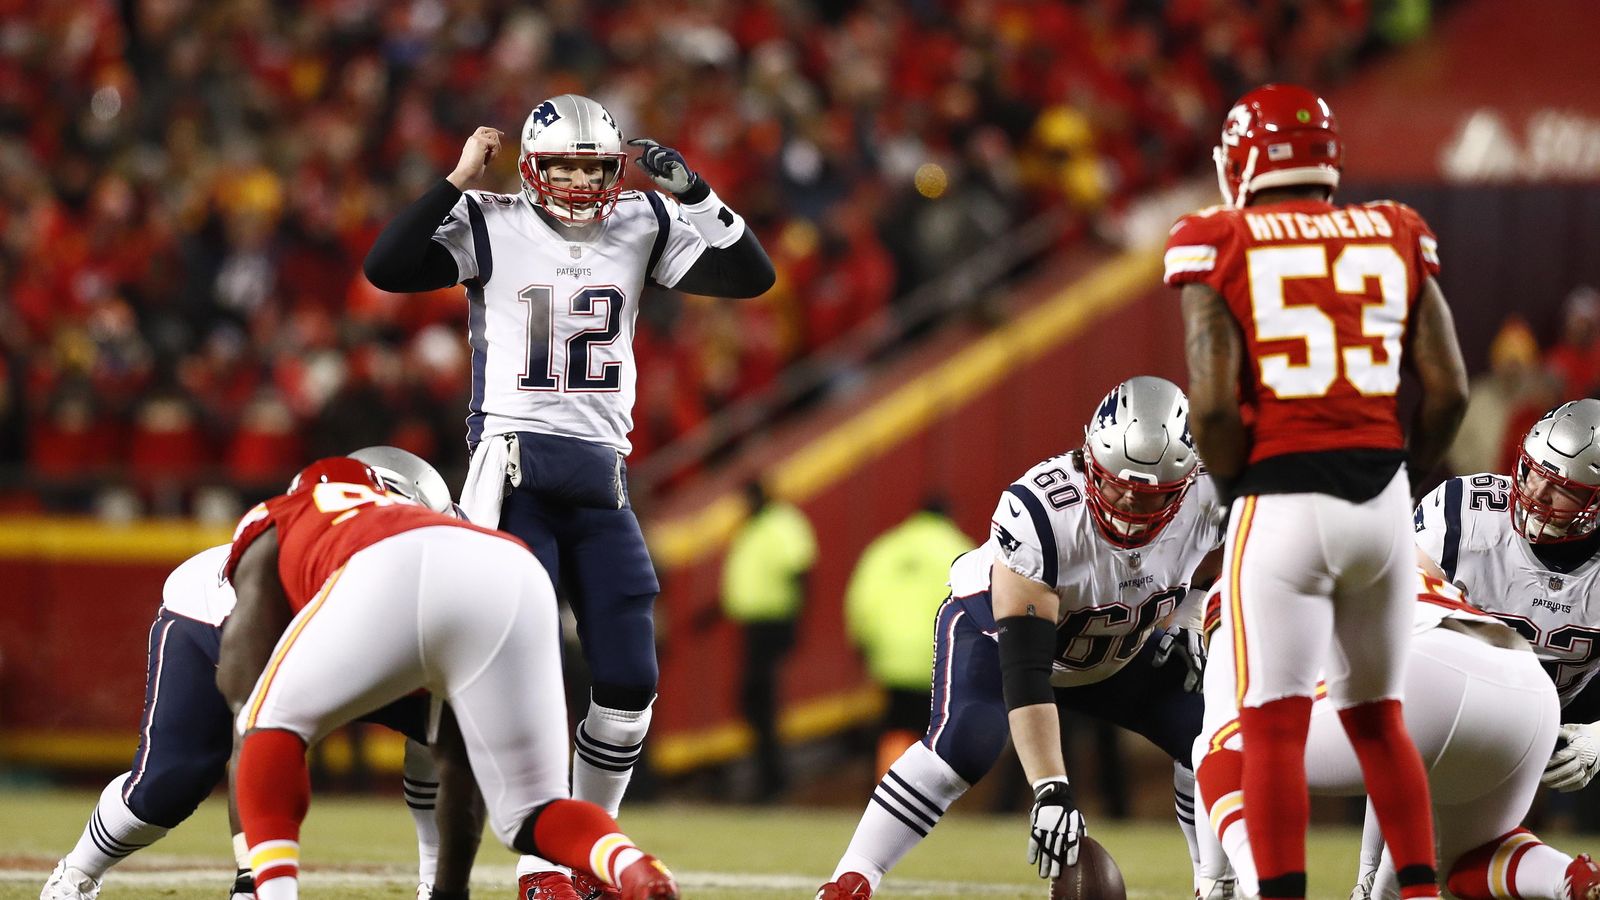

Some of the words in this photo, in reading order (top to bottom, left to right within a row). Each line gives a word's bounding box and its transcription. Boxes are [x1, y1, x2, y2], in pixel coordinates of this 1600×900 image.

[1244, 208, 1393, 241] HITCHENS
[556, 267, 592, 280] PATRIOTS
[517, 284, 626, 392] 12
[1246, 243, 1408, 400] 53
[1031, 466, 1083, 512] 60
[1470, 474, 1511, 513] 62
[1118, 574, 1155, 591] PATRIOTS
[1531, 597, 1572, 614] PATRIOTS
